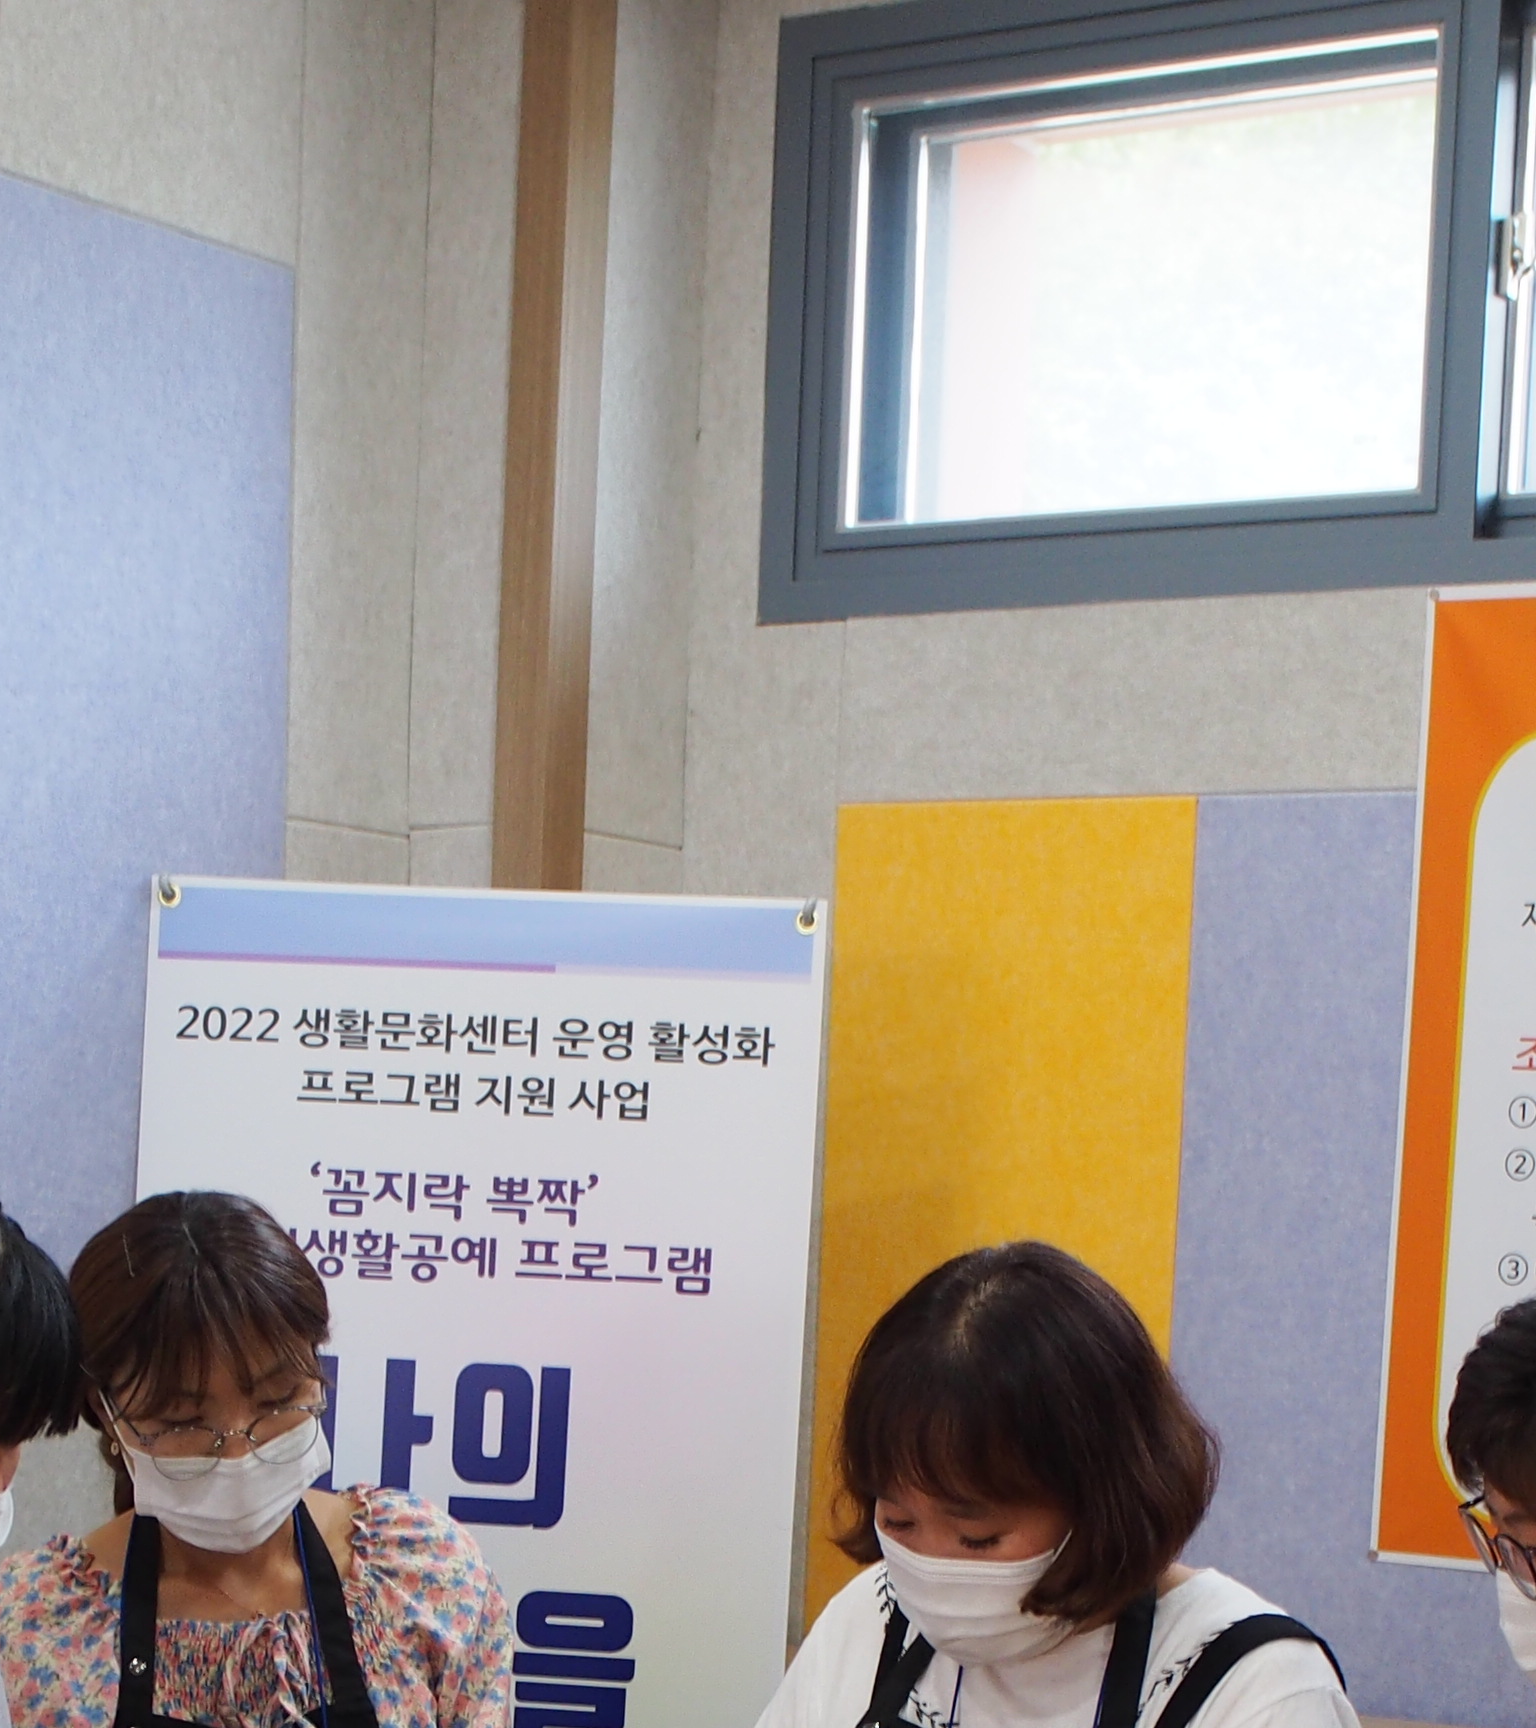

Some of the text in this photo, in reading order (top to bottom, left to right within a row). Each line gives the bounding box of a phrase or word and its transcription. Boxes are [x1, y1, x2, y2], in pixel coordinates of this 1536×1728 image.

[174, 1004, 777, 1069] 2022 생활문화센터 운영 활성화
[296, 1069, 652, 1123] 프로그램 지원 사업
[289, 1227, 715, 1297] 생활공예 프로그램
